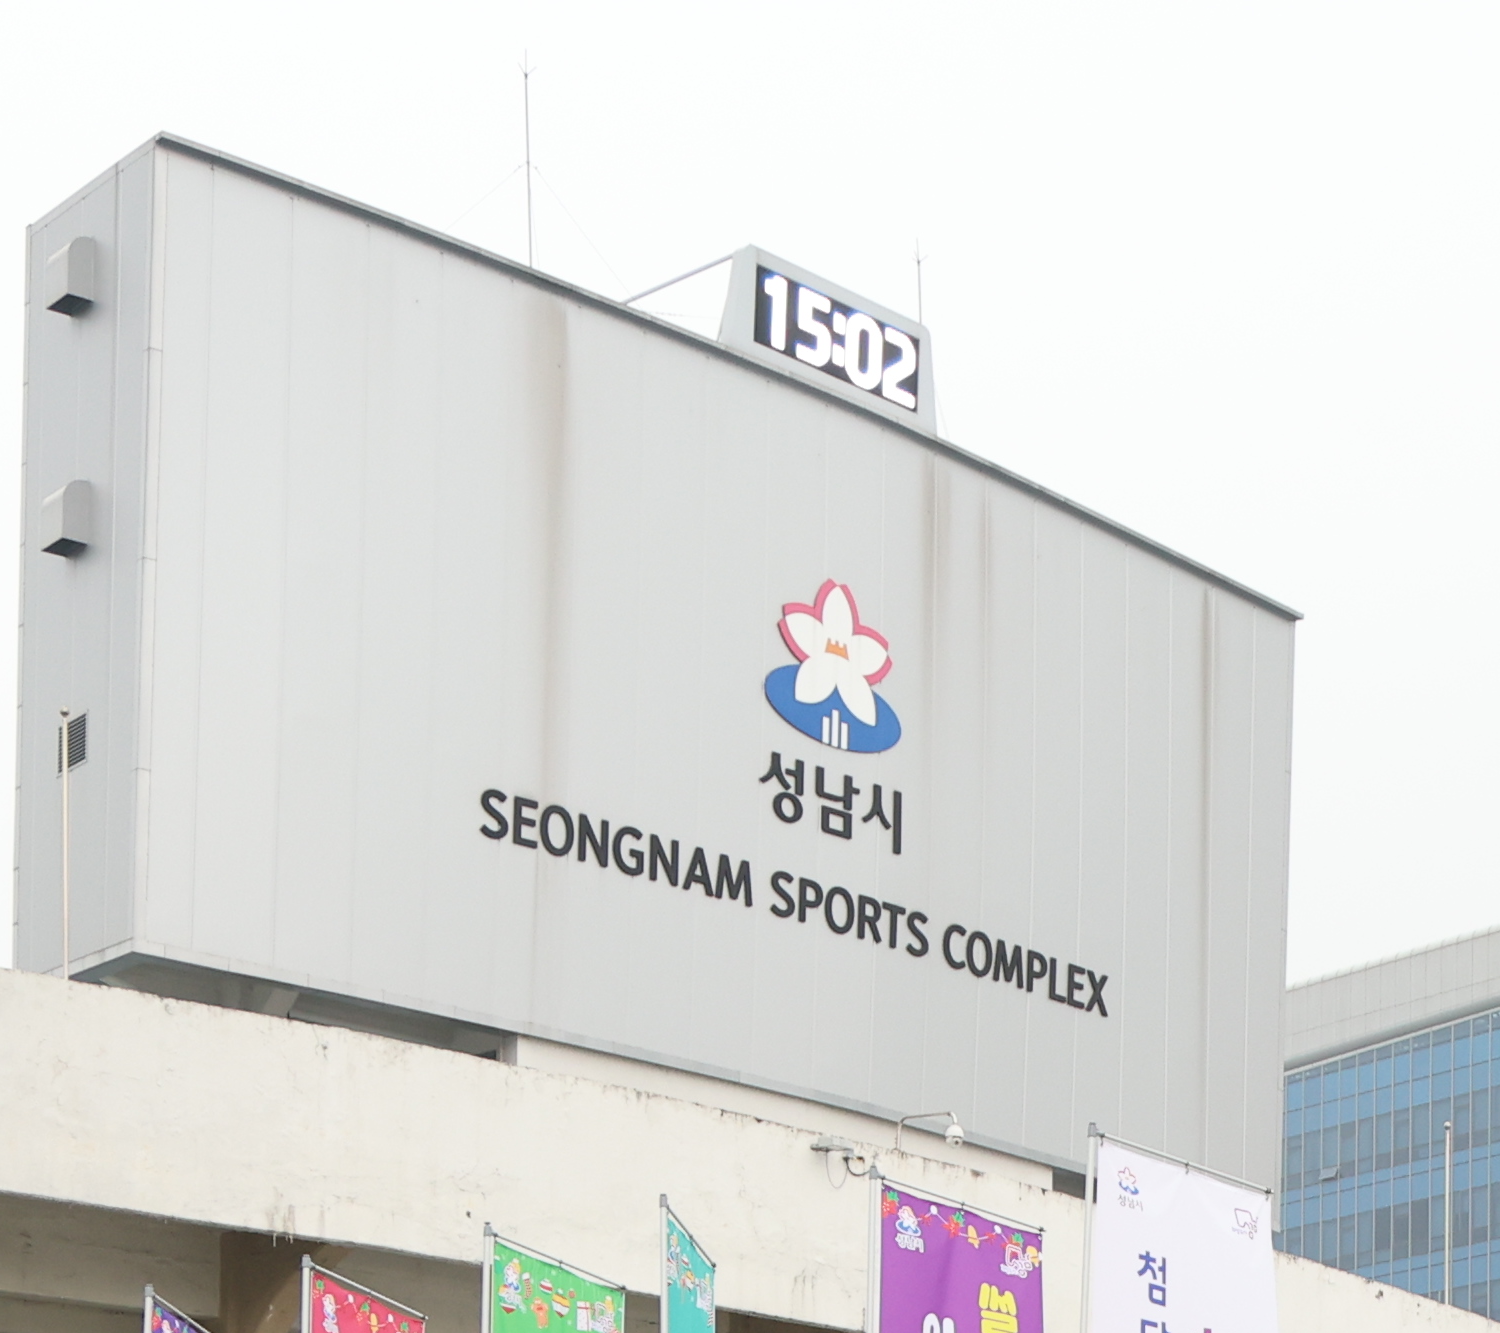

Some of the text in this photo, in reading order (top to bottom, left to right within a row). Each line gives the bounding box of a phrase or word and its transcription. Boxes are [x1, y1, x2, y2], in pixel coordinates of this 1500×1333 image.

[762, 272, 918, 412] 15:02
[759, 751, 904, 855] 성남시
[479, 788, 1109, 1017] SEONGNAM SPORTS COMPLEX
